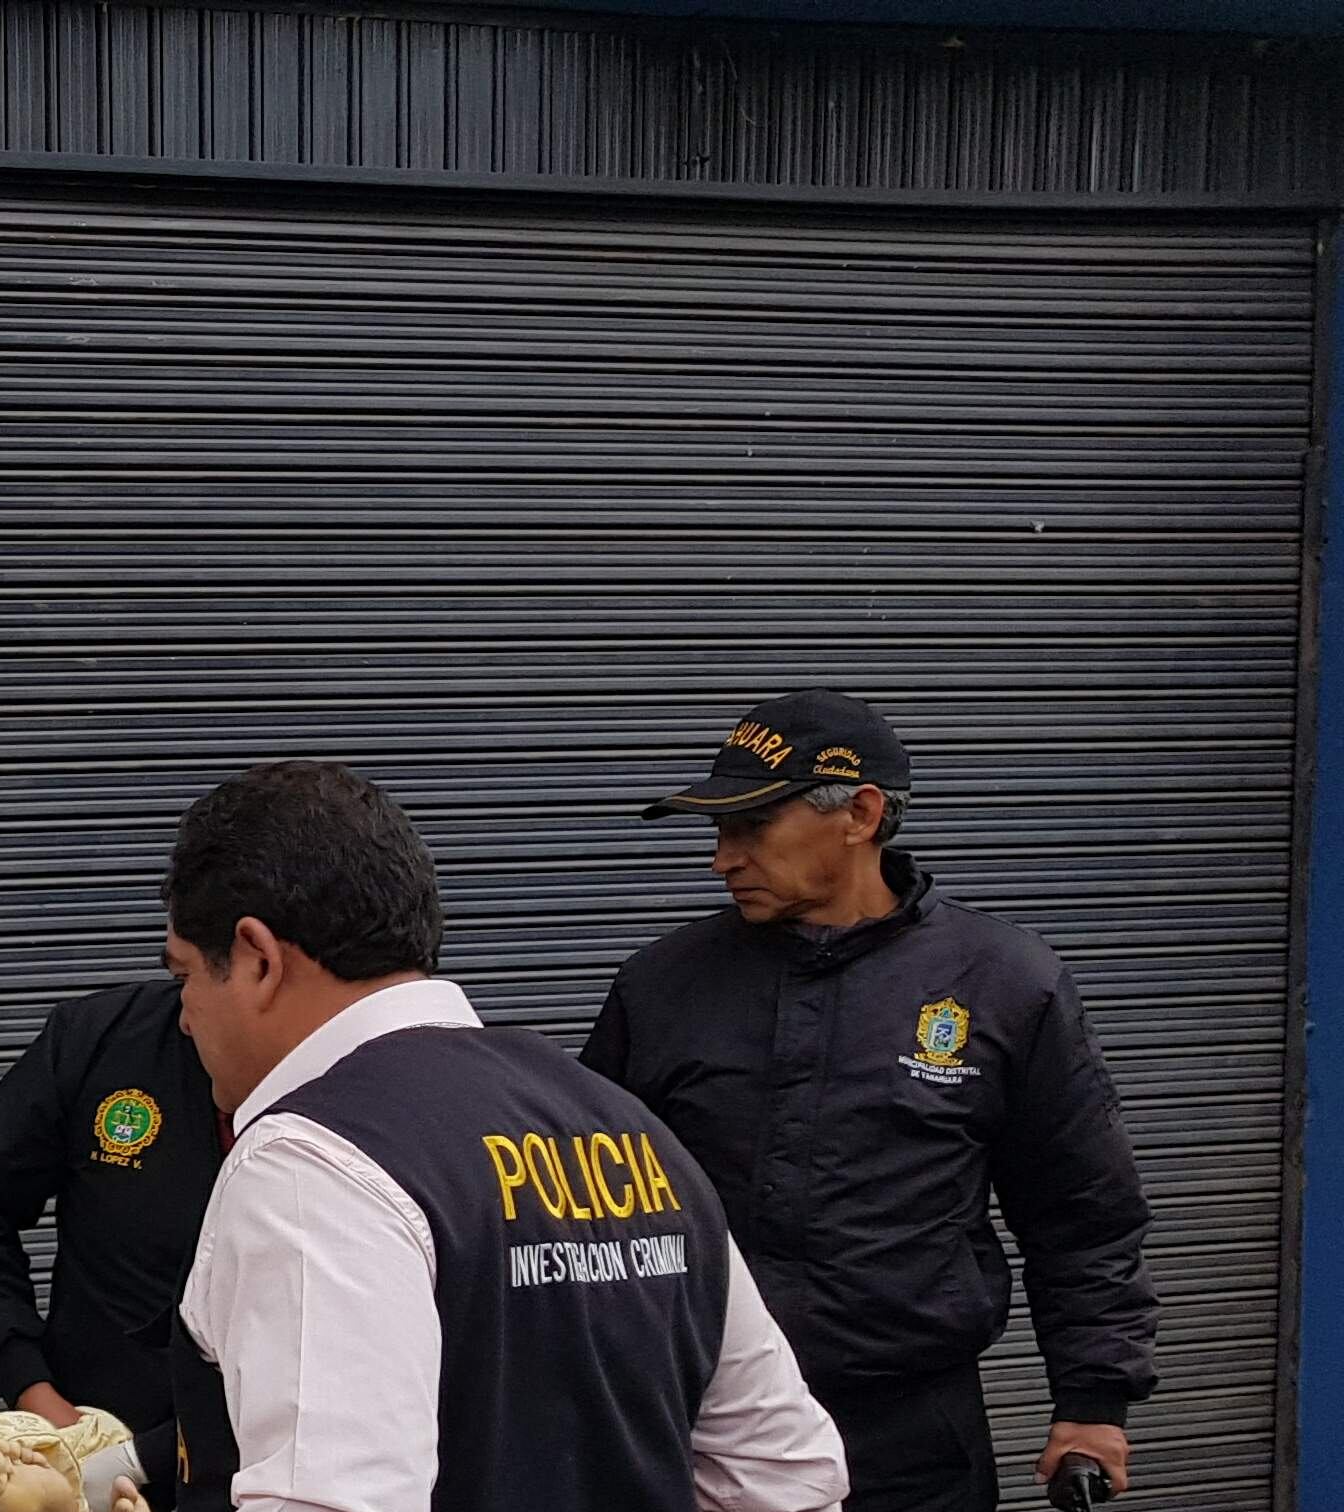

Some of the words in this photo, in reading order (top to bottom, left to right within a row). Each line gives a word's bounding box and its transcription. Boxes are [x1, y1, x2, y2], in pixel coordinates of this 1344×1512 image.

[816, 747, 862, 766] SEGURIDAD
[100, 1152, 130, 1167] LOPEZ
[482, 1132, 681, 1221] POLICIA
[630, 1234, 688, 1278] CRIMINAL
